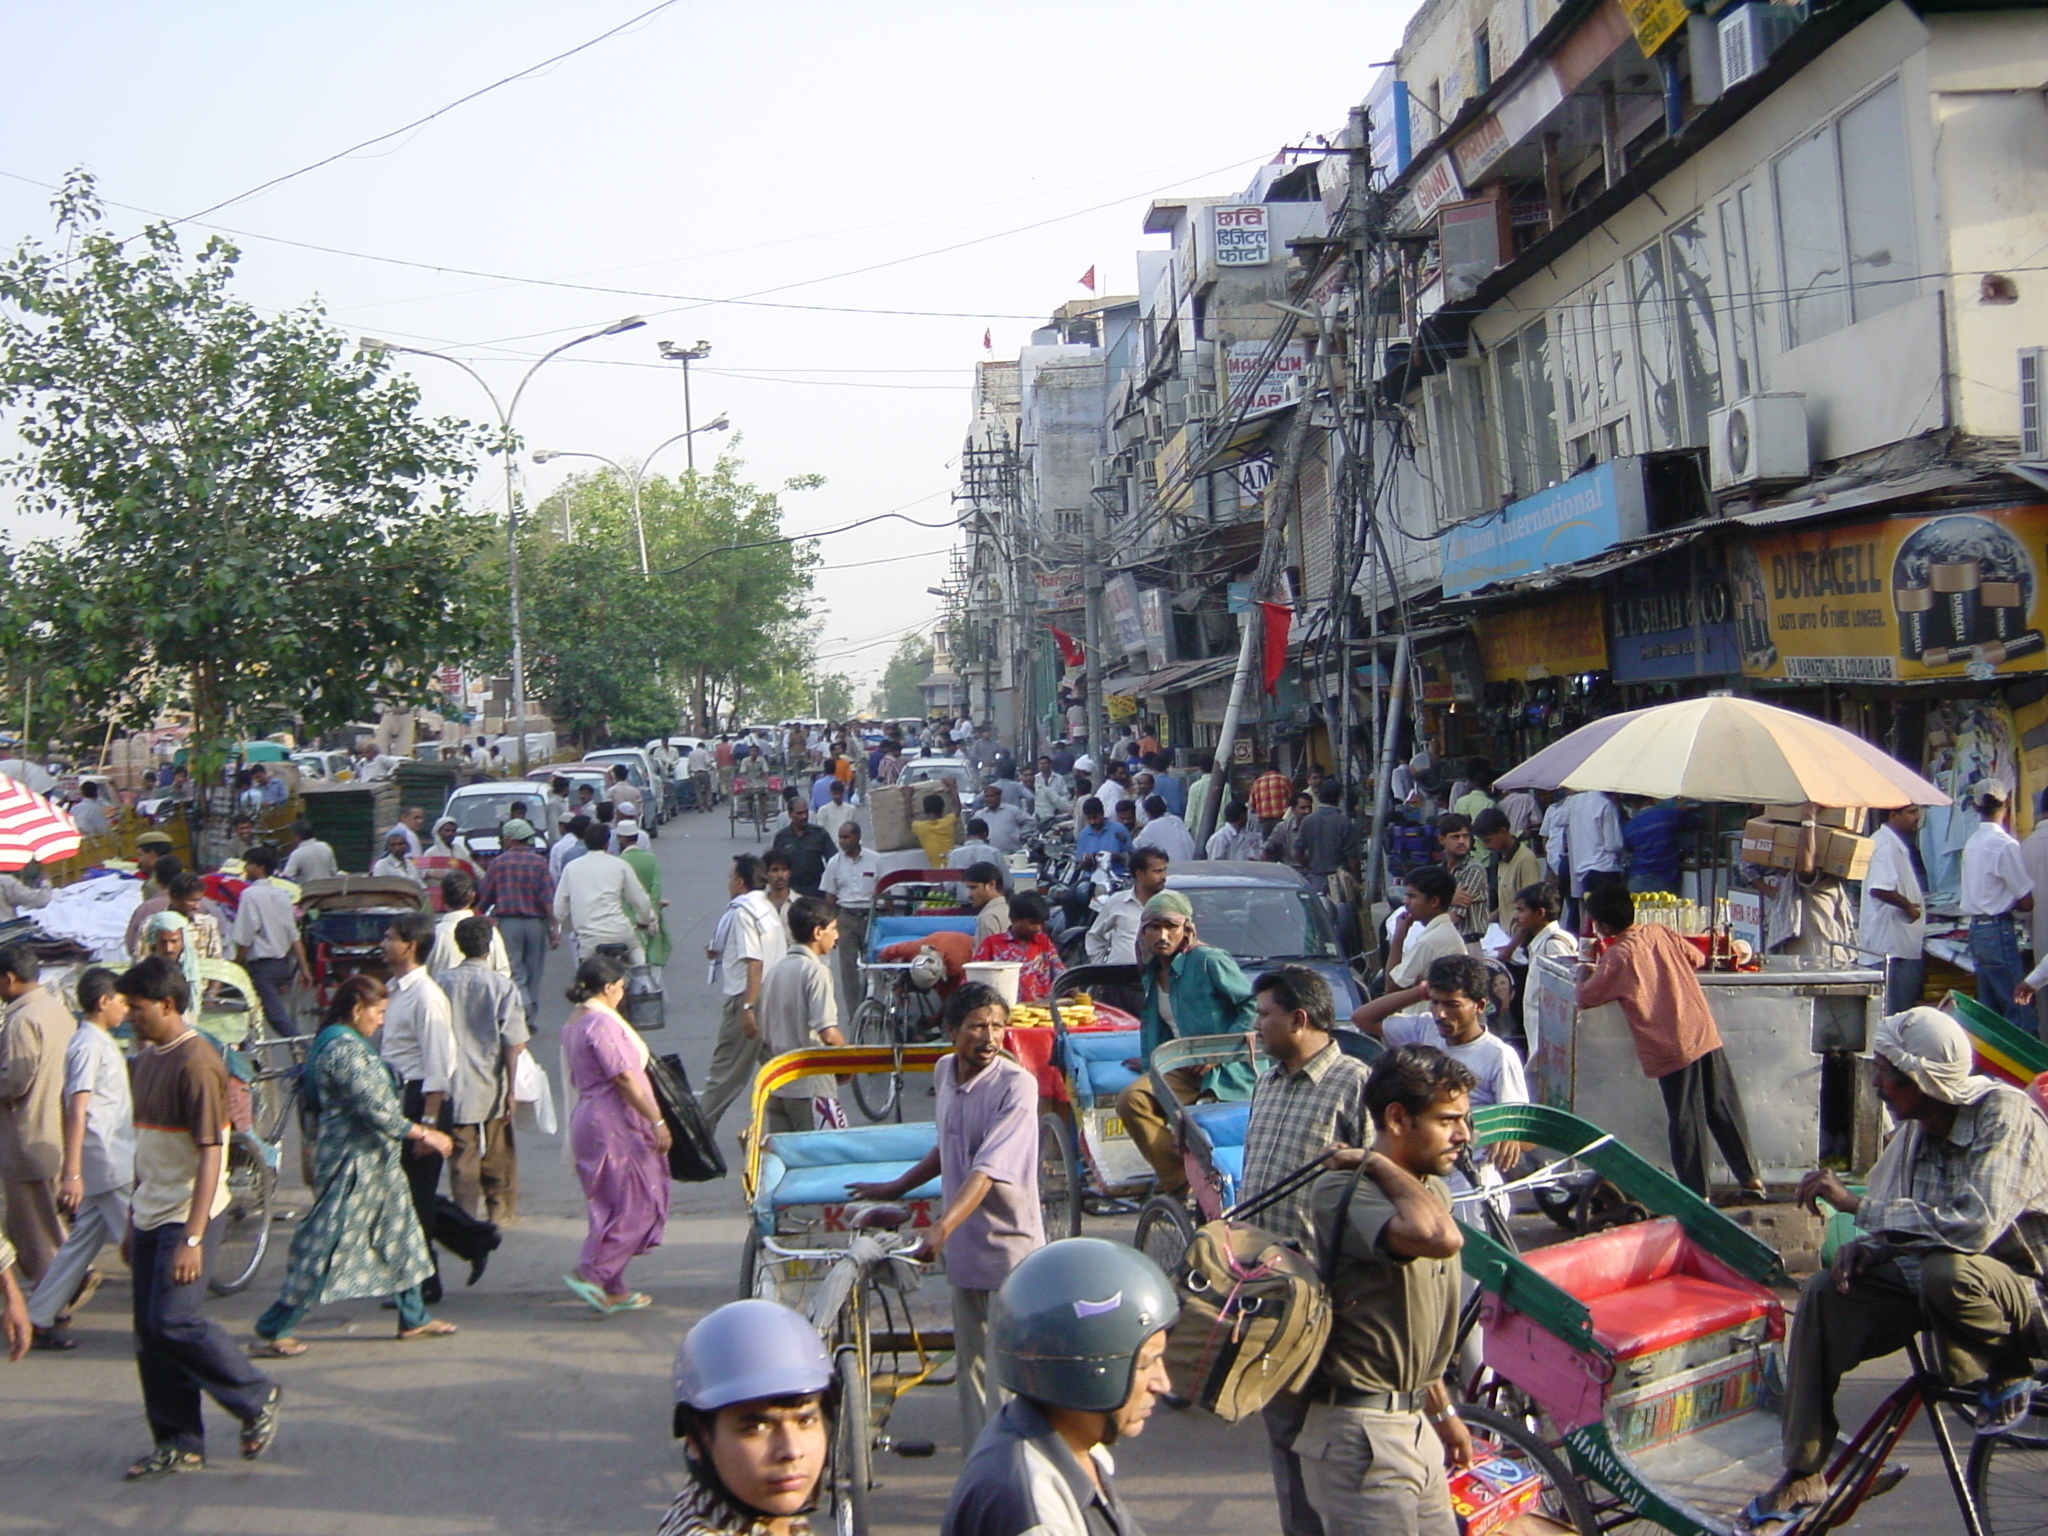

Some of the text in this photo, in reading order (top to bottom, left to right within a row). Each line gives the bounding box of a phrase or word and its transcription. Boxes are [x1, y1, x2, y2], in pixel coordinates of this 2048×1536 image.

[1416, 162, 1451, 212] GINNI
[1216, 207, 1265, 226] छवि
[1216, 228, 1267, 246] डिजिटल
[1217, 244, 1266, 262] फोटो
[1496, 476, 1604, 545] International
[1772, 542, 1882, 600] DURACELL
[1612, 602, 1625, 638] K
[1640, 592, 1683, 634] SHAH
[1700, 583, 1726, 624] CO
[1819, 603, 1829, 628] 6
[1912, 612, 1923, 653] DURACELL
[1954, 593, 1966, 642] DURACELL
